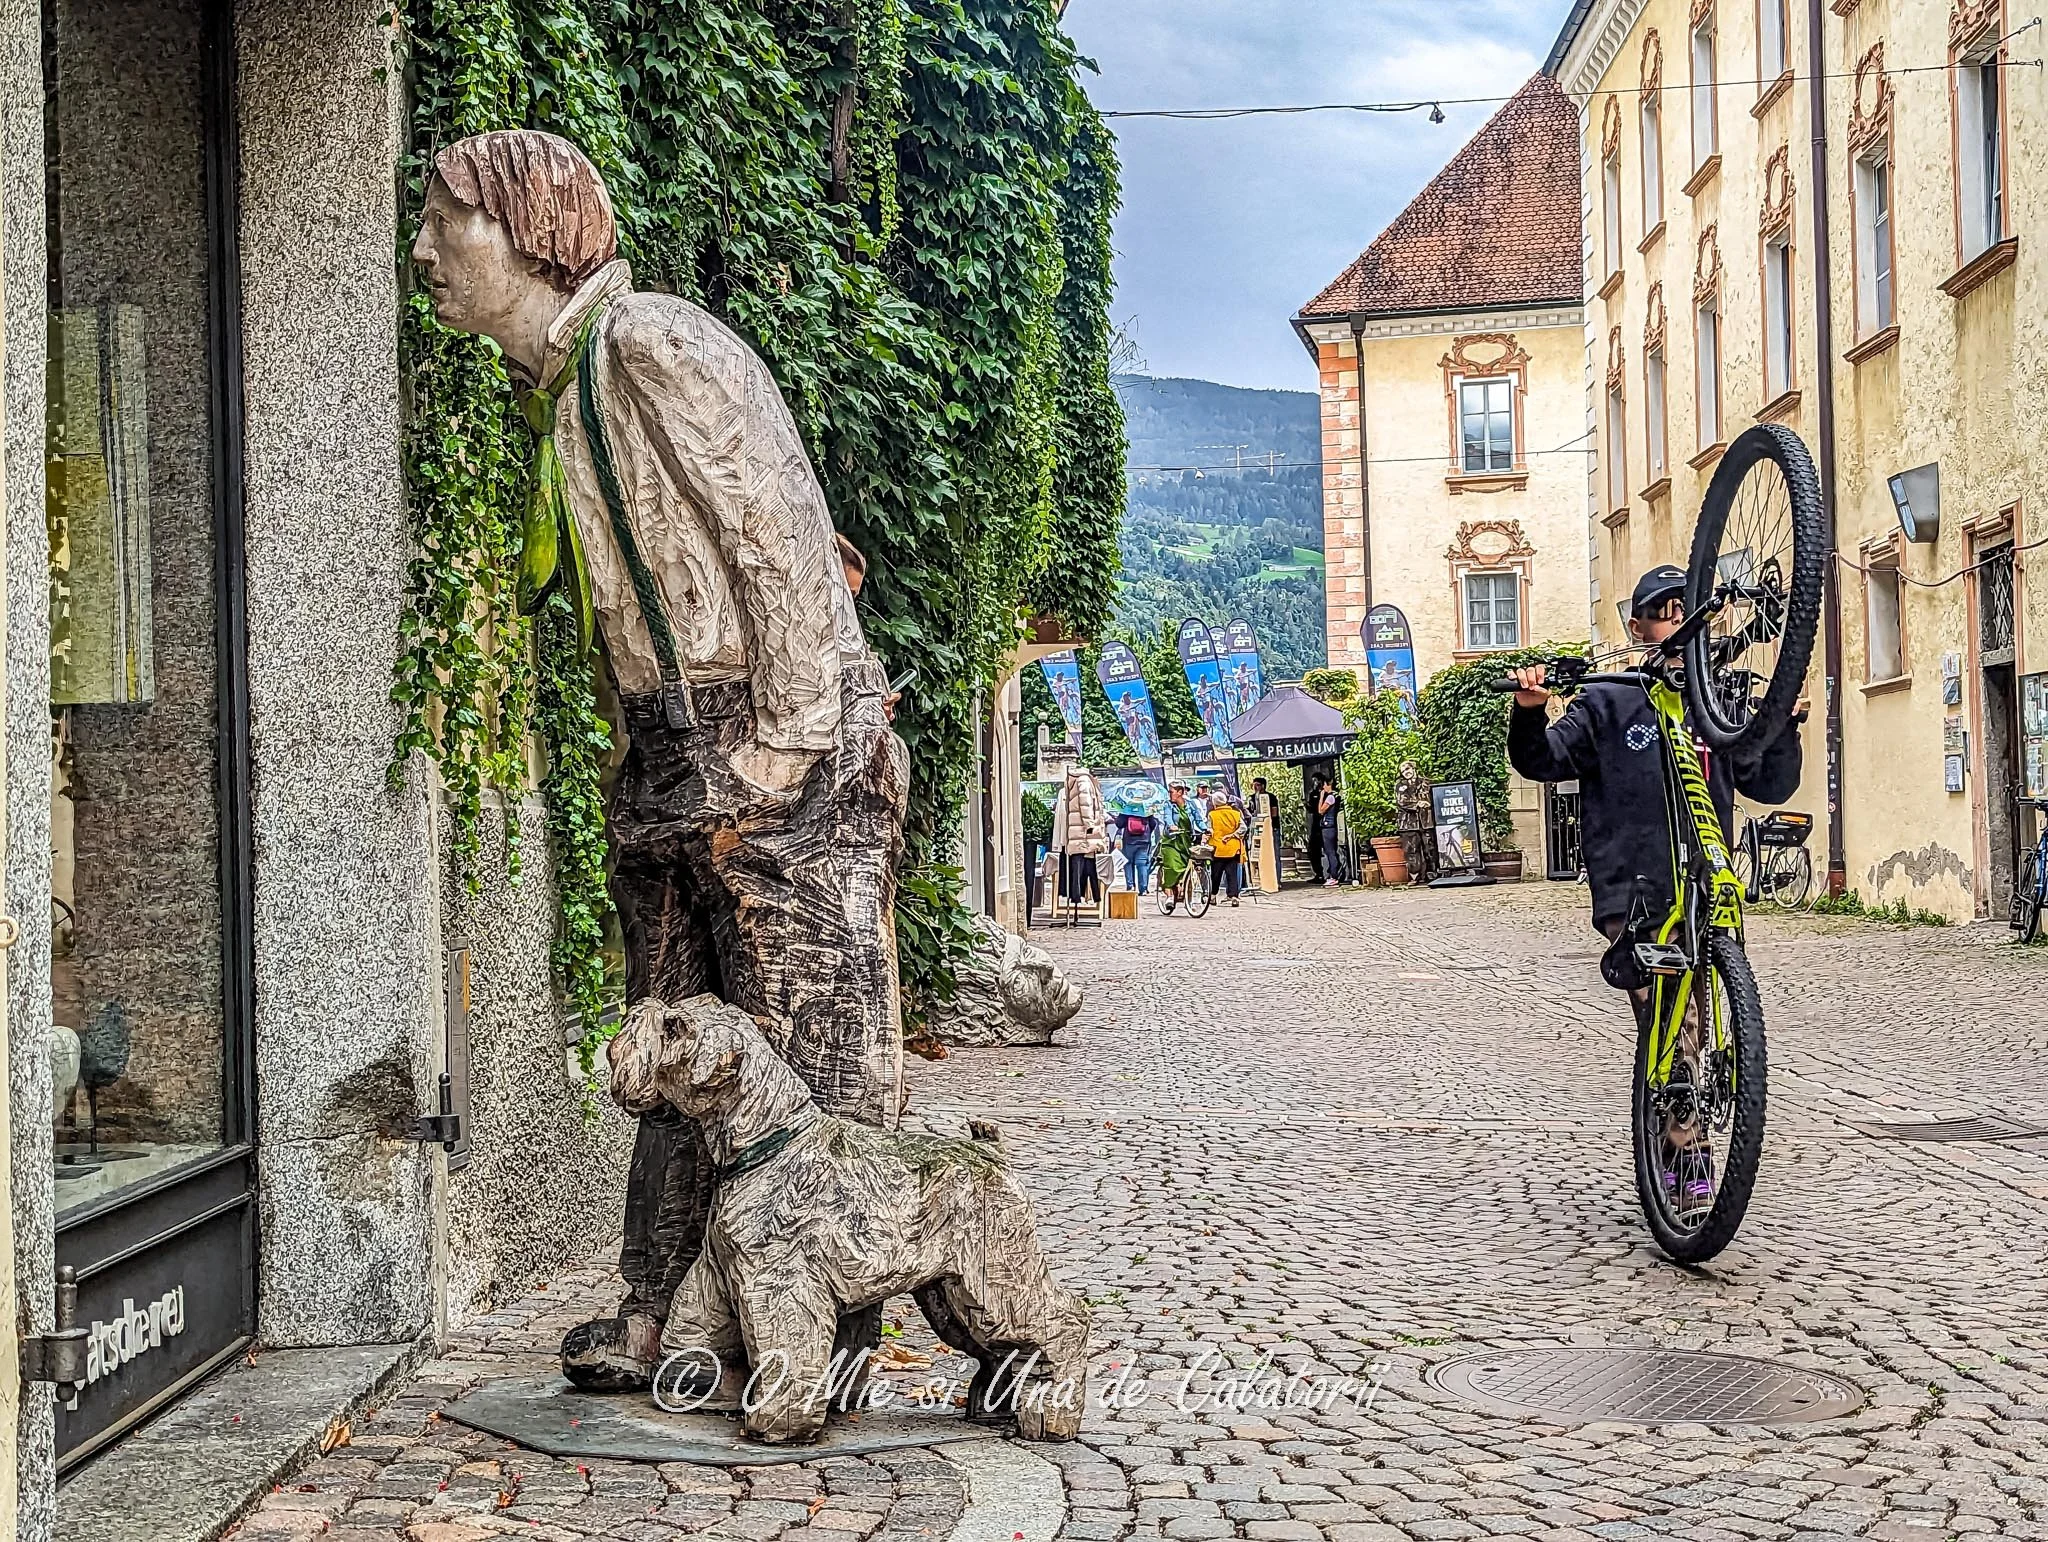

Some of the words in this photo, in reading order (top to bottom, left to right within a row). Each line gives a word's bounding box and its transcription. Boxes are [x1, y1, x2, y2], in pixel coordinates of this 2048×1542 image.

[1267, 741, 1336, 757] PREMIUM
[1443, 797, 1464, 807] BIKE
[1441, 806, 1468, 817] WASH
